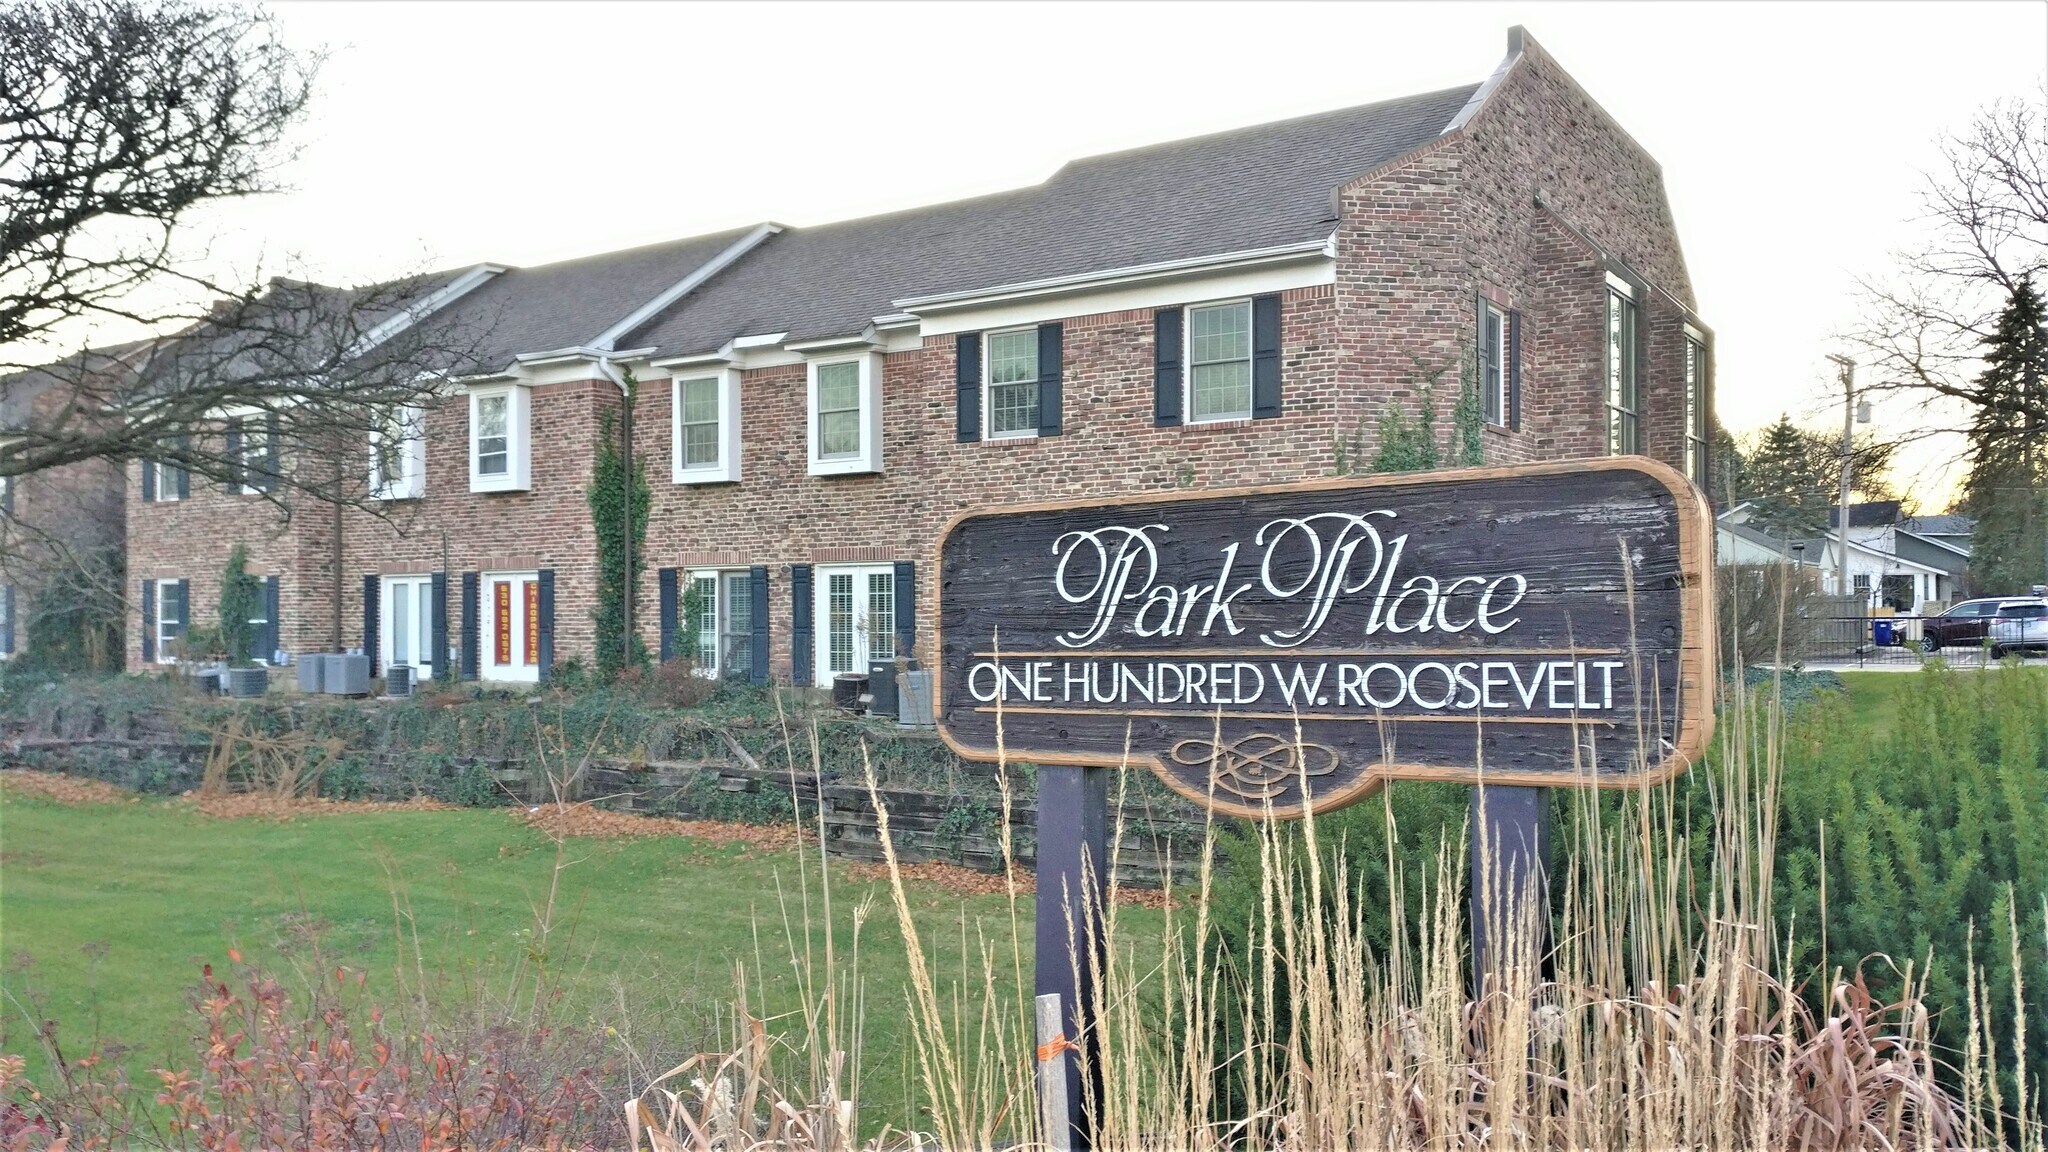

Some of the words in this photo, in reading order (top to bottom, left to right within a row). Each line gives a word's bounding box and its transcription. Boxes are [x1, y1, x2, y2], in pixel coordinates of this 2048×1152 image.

[1052, 523, 1252, 649] Park
[1255, 509, 1528, 648] Place
[530, 583, 538, 664] CHIROPRACTOR
[968, 661, 1052, 703] ONE
[1064, 662, 1265, 705] HUNDRED
[1271, 662, 1329, 708] W.
[1338, 660, 1625, 711] ROOSEVELT
